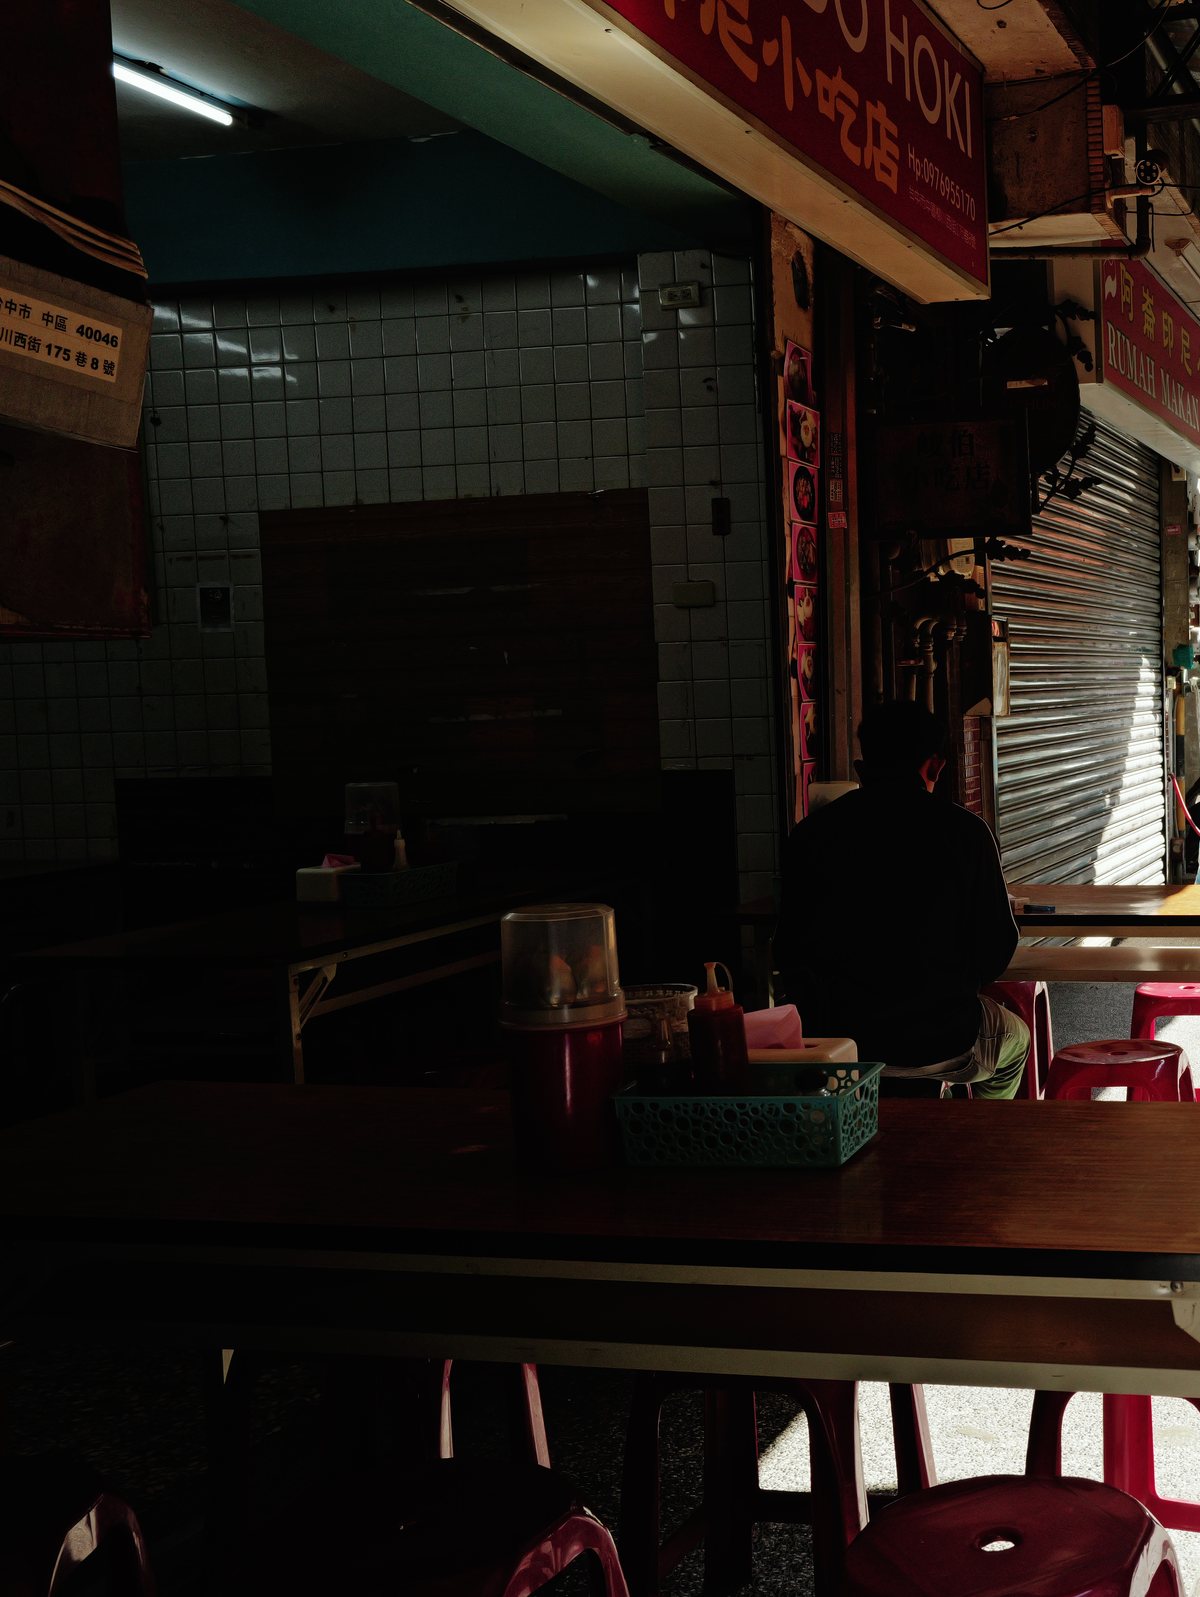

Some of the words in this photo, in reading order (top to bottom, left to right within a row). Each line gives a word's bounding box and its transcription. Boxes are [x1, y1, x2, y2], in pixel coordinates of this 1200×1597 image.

[663, 0, 900, 195] 尼小吃店
[883, 0, 973, 160] HOKI
[42, 311, 68, 332] 中區
[76, 324, 119, 348] 40046
[1106, 320, 1156, 399] RUMAH
[1160, 367, 1200, 433] MAKAN
